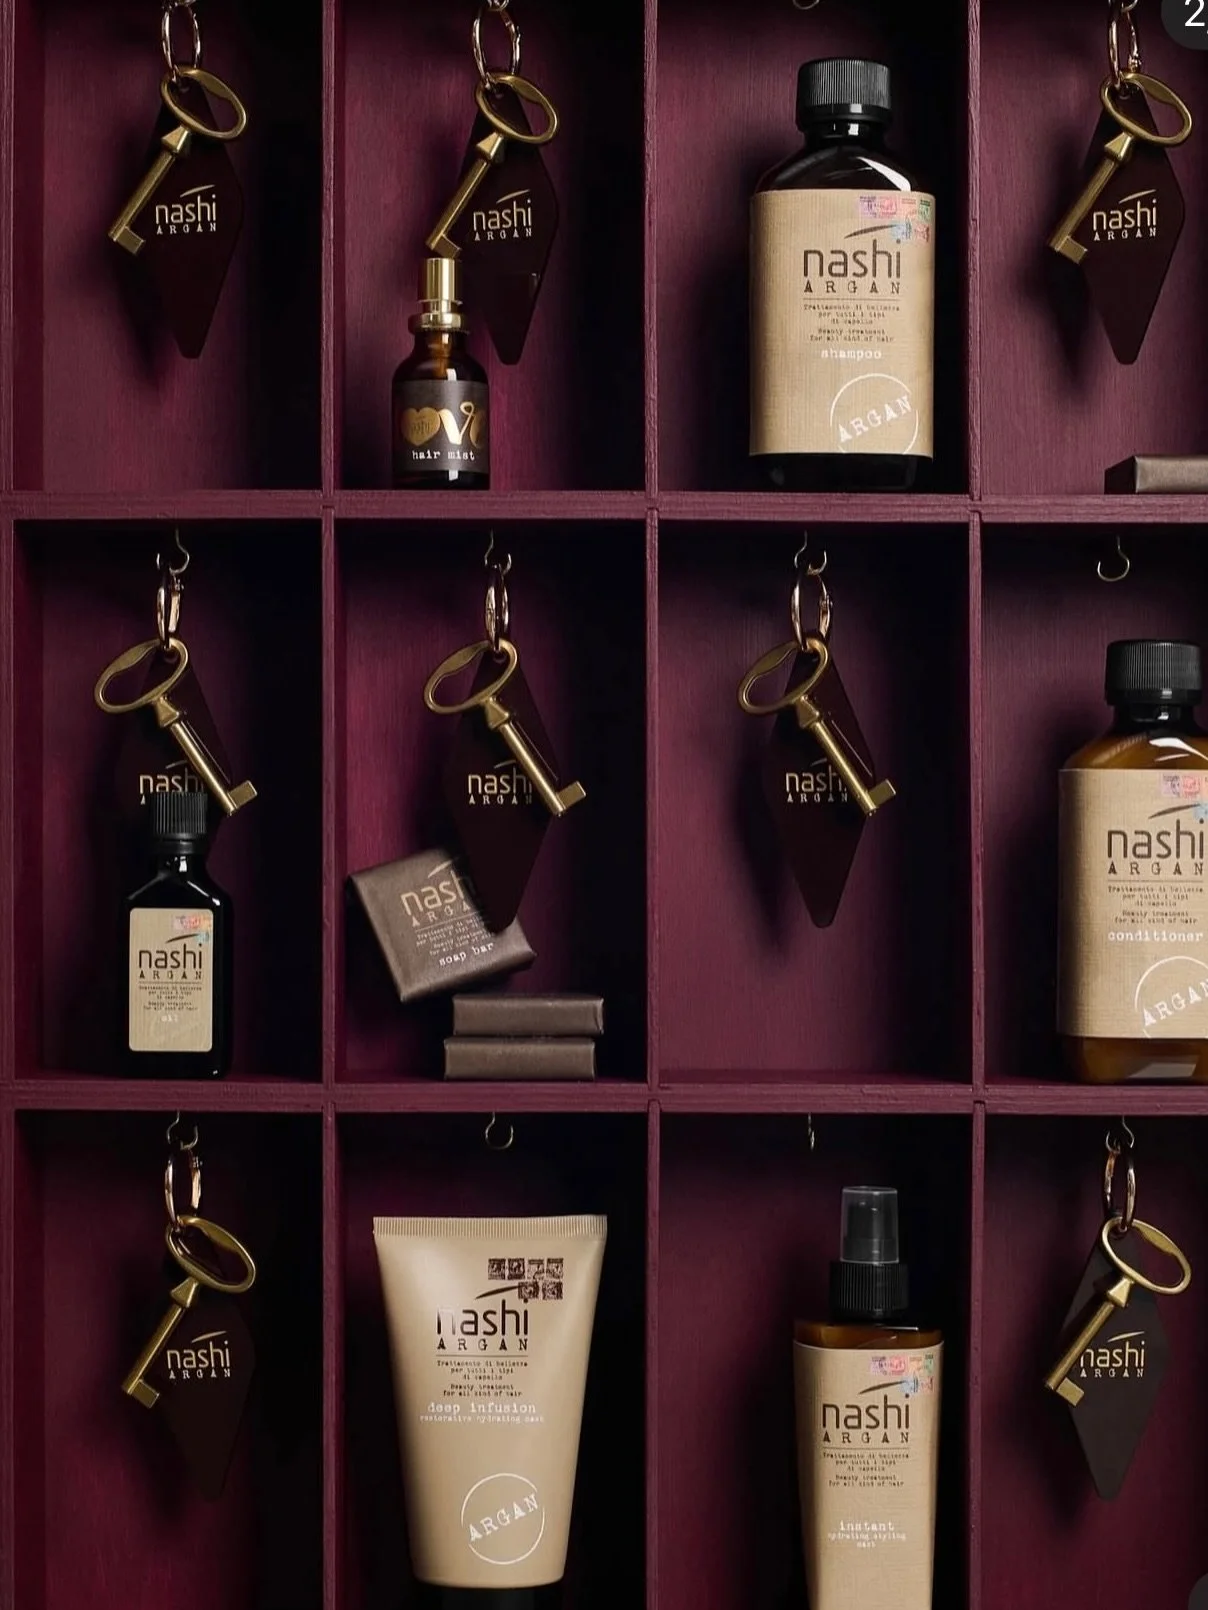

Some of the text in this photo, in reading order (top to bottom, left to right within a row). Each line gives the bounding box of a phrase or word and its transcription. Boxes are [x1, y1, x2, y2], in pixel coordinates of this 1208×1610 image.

[156, 194, 216, 224] nashi
[473, 199, 531, 231] nashi
[1093, 199, 1156, 231] nashi
[157, 223, 216, 235] ARGAN
[474, 228, 532, 241] ARGAN
[1093, 228, 1156, 241] ARGAN
[803, 239, 900, 278] nashi
[803, 281, 900, 294] ARGAN
[821, 349, 882, 361] shampoo
[839, 395, 911, 442] ARGAN
[412, 449, 475, 461] hair mist
[140, 767, 204, 794] nash
[786, 765, 847, 792] nash
[1108, 818, 1204, 859] nashi
[1108, 861, 1203, 875] ARGAN
[401, 870, 464, 916] nas
[411, 900, 471, 927] ARGA
[1107, 930, 1204, 942] conditioner
[139, 943, 202, 969] nashi
[439, 942, 494, 966] soap bar
[140, 970, 202, 980] ARGAN
[437, 1298, 528, 1335] nashi
[167, 1340, 230, 1369] nashi
[437, 1337, 528, 1351] ARGAN
[1080, 1341, 1145, 1367] nashi
[168, 1368, 231, 1379] ARGAN
[1080, 1368, 1144, 1378] ARGAN
[428, 1402, 536, 1415] deep infusion
[822, 1393, 909, 1429] nashi
[822, 1431, 909, 1443] ARGAN
[469, 1493, 538, 1541] ARGAN
[840, 1520, 894, 1531] instant
